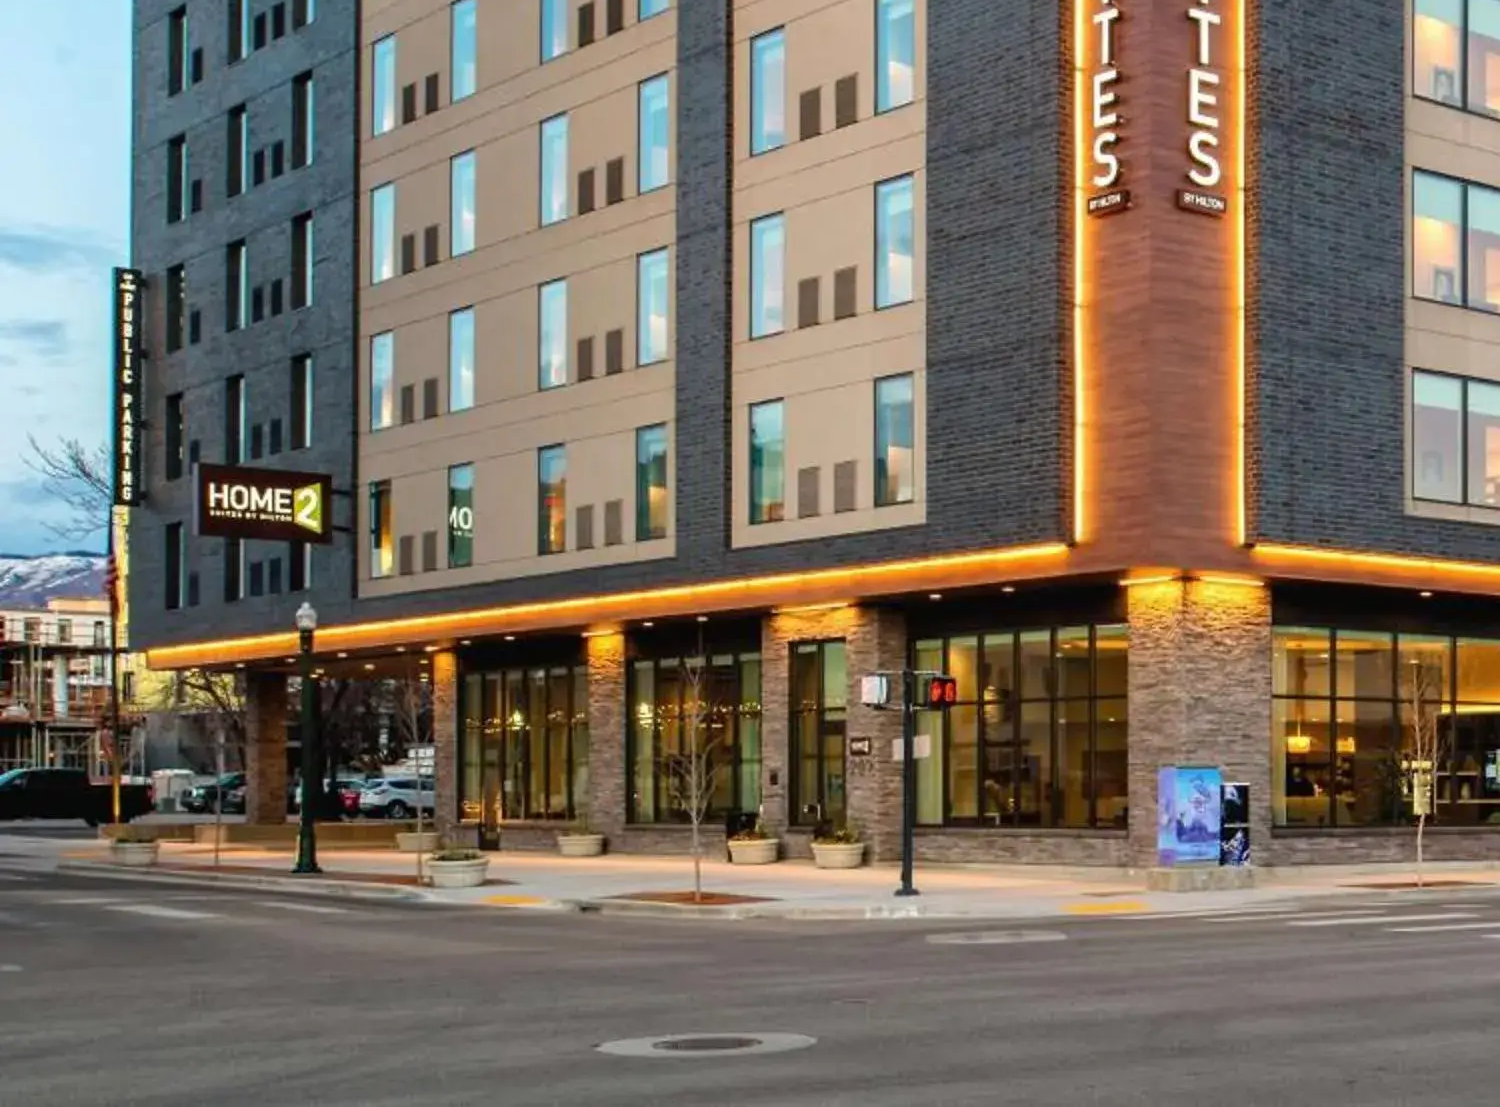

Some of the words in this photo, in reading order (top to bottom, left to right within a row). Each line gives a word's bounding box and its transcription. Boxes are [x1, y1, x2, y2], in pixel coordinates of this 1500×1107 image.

[123, 292, 133, 383] PUBLIC
[122, 394, 132, 500] PARKING
[209, 510, 242, 519] SUITES
[259, 513, 292, 522] HILTON
